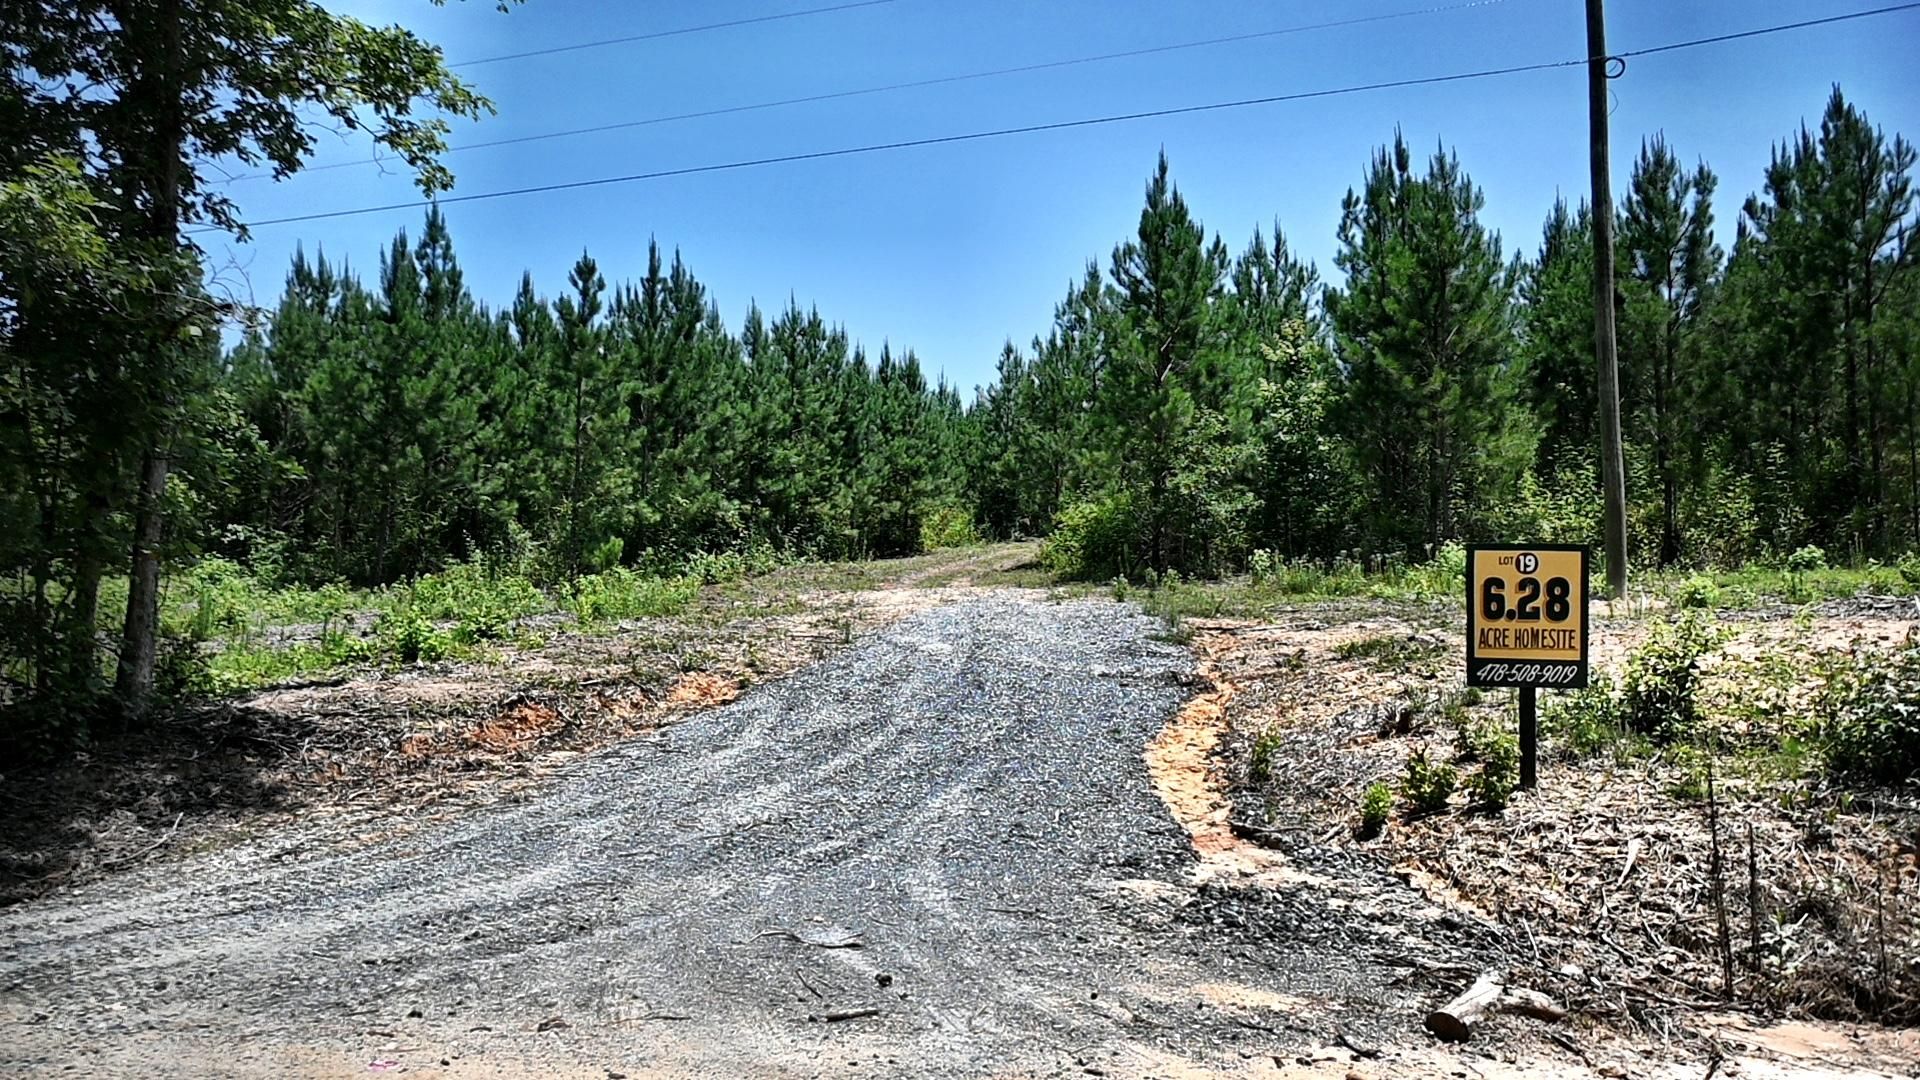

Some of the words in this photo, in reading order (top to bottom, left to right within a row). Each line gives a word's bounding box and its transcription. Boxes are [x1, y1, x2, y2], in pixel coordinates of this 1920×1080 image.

[1498, 556, 1514, 565] LOT
[1518, 555, 1536, 572] 19
[1481, 577, 1570, 622] 6.28
[1478, 628, 1510, 649] ACRE
[1514, 627, 1577, 649] HOMESITE
[1476, 663, 1578, 683] 478-508-9019
